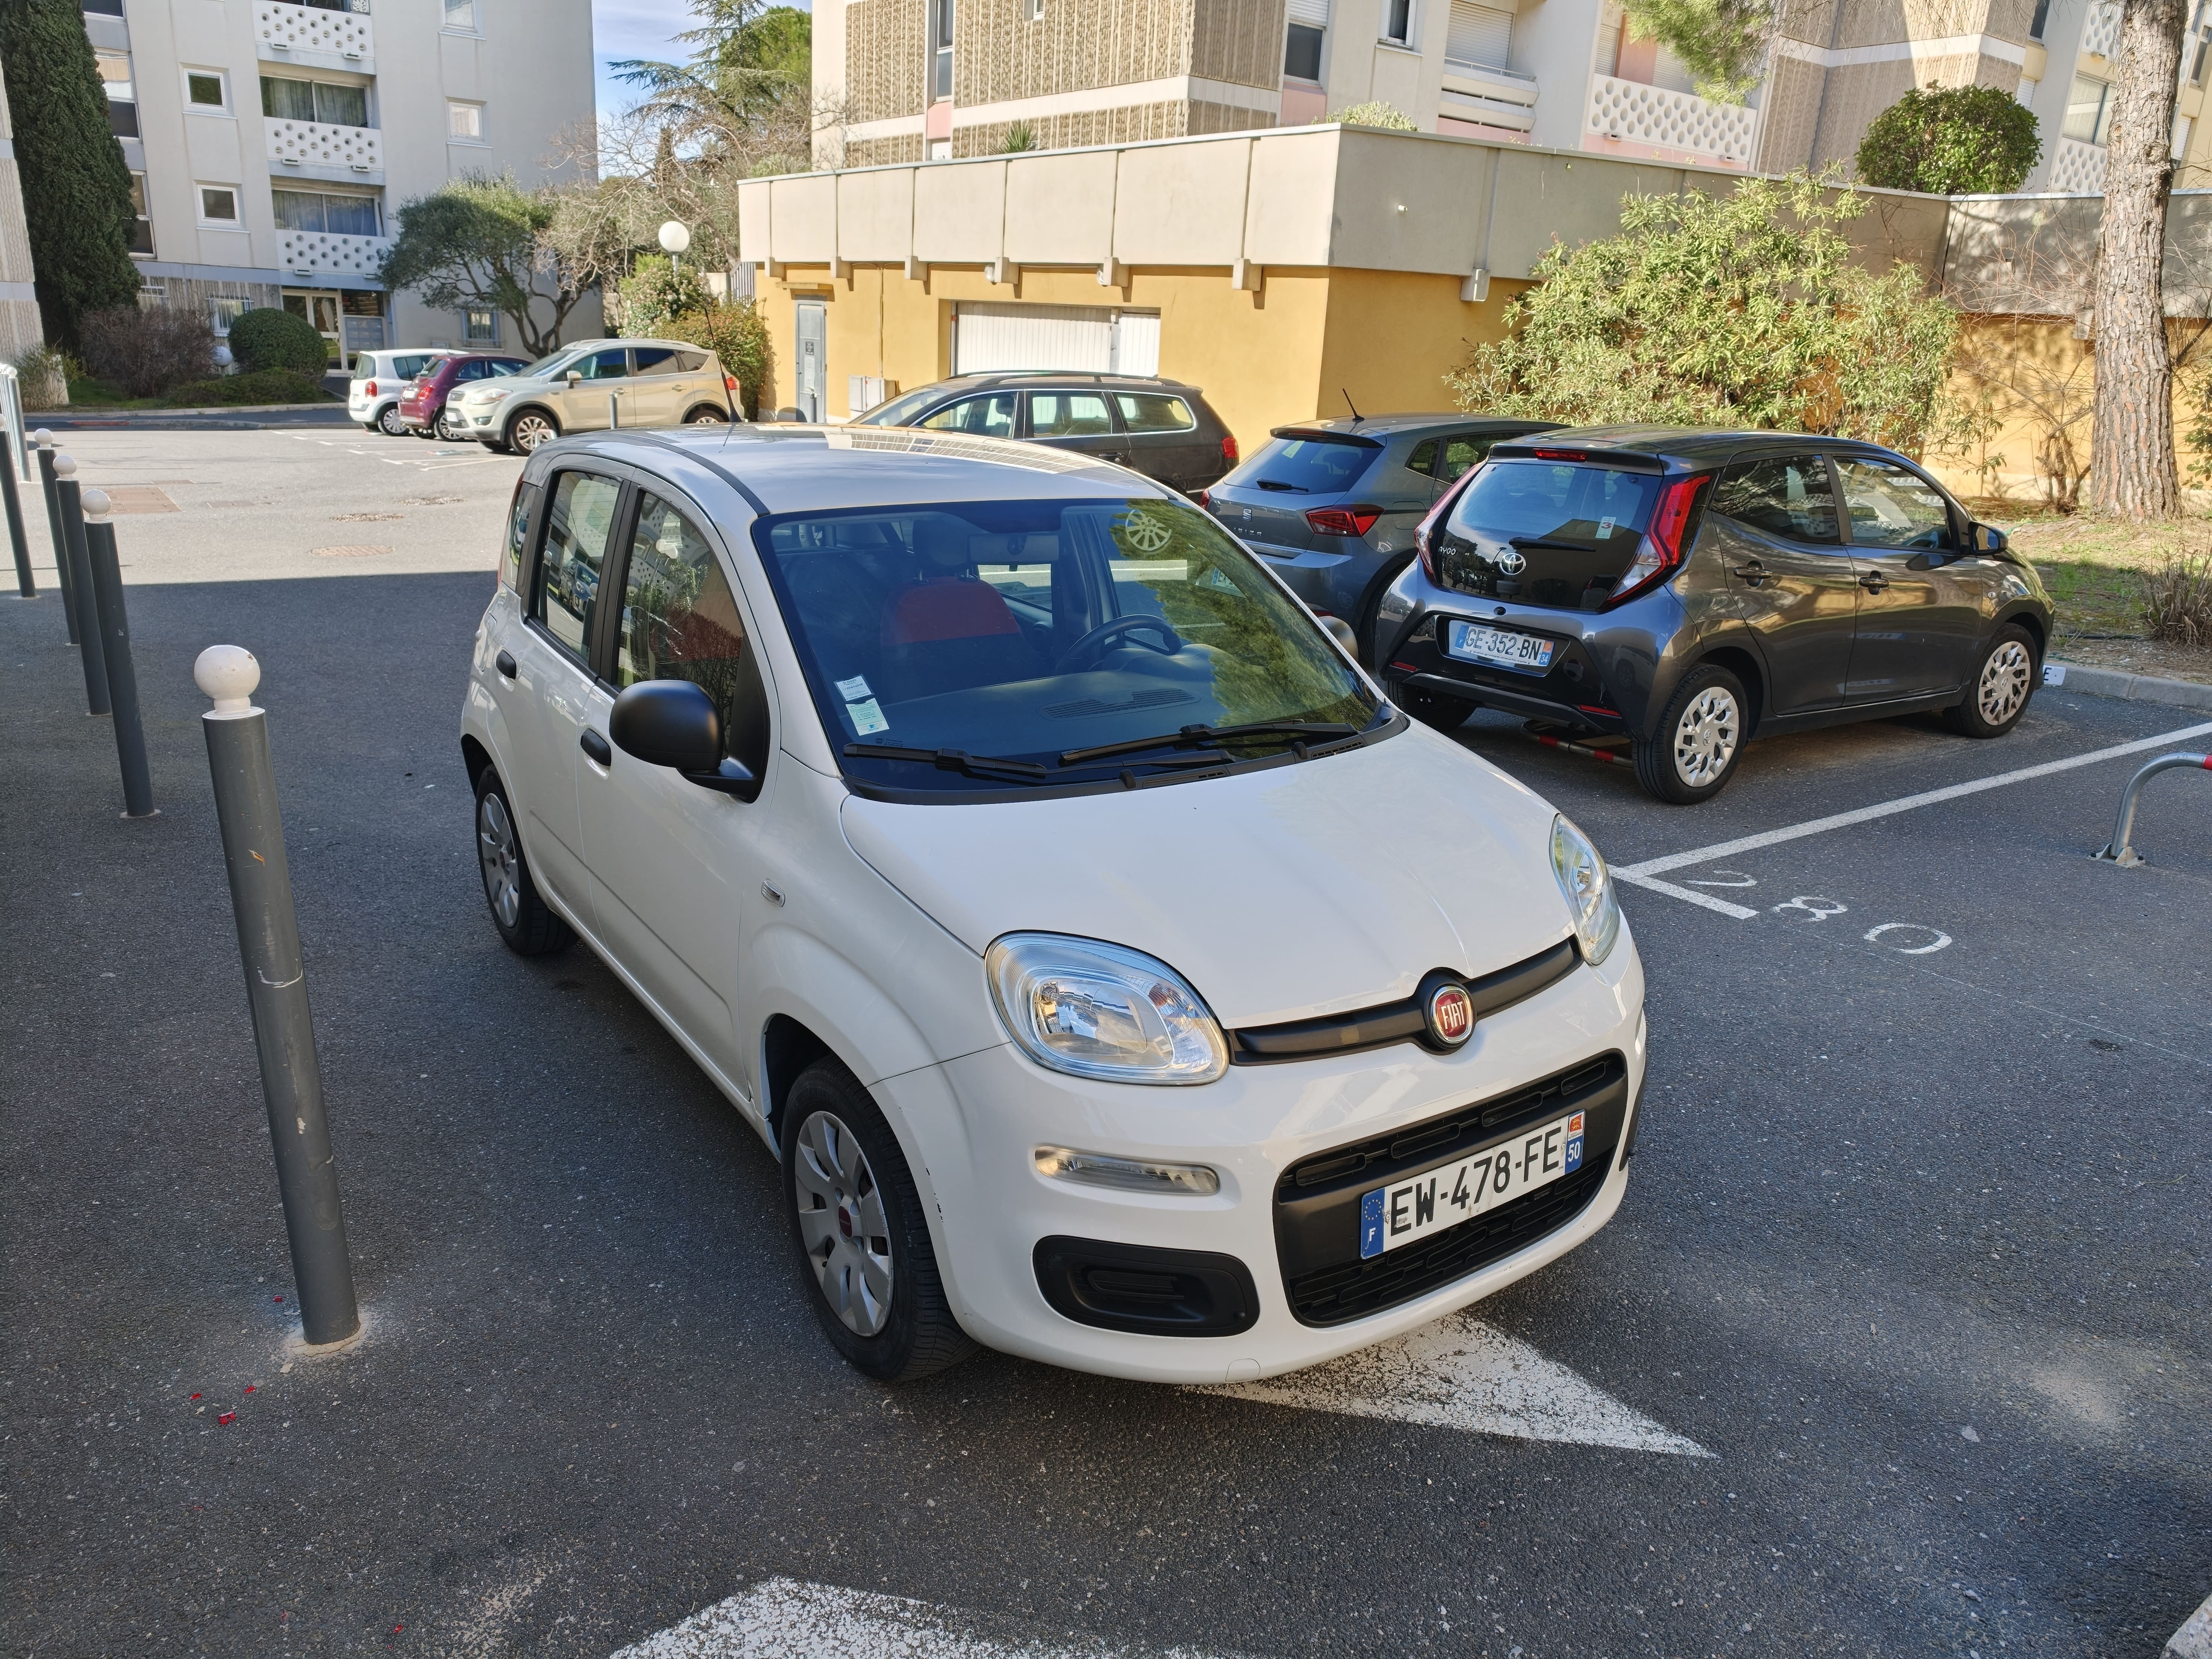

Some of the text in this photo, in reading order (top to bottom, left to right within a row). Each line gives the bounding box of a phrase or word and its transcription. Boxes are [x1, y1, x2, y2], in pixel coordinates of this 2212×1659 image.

[1438, 546, 1456, 555] AYGO
[1465, 628, 1542, 660] GE-352-BN
[1540, 654, 1549, 663] 34
[1682, 869, 1952, 955] 280
[1441, 1001, 1465, 1030] FIAT
[1568, 1141, 1580, 1162] 50
[1391, 1126, 1562, 1237] EW-478-FE
[1369, 1227, 1376, 1241] F
